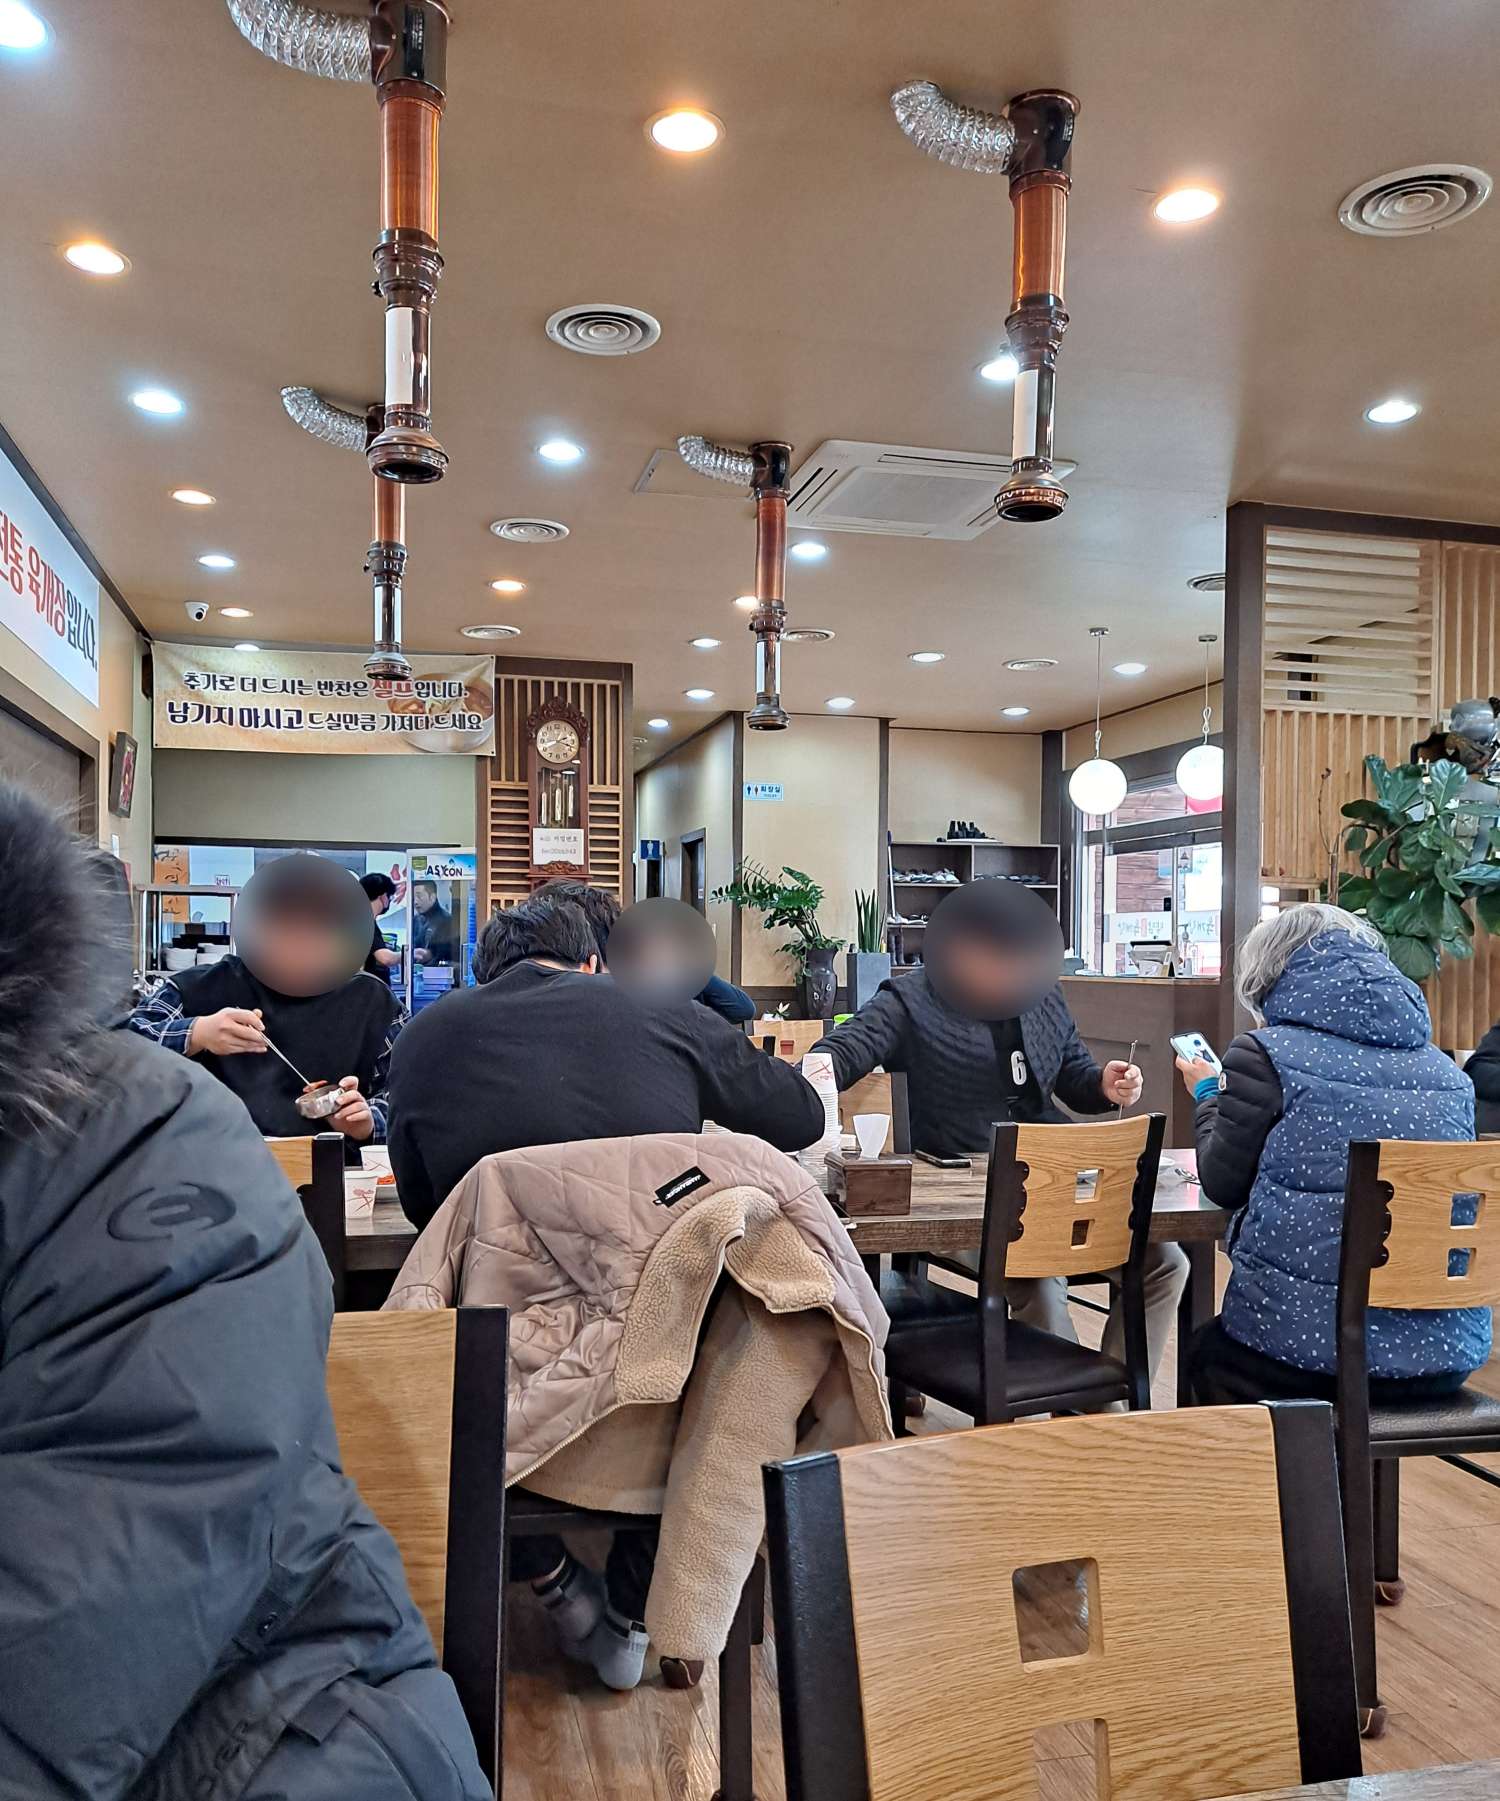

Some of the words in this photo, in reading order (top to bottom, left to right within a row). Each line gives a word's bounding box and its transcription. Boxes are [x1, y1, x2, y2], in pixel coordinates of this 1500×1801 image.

[183, 672, 235, 691] 추가로
[240, 677, 257, 693] 더
[262, 678, 314, 696] 드시는
[317, 680, 369, 697] 반찬은
[167, 701, 234, 726] 남기지
[239, 707, 304, 730] 마시고
[308, 713, 377, 731] 드실만큼
[380, 714, 434, 731] 가져다
[434, 713, 483, 730] 드세요
[1010, 1050, 1027, 1086] 6
